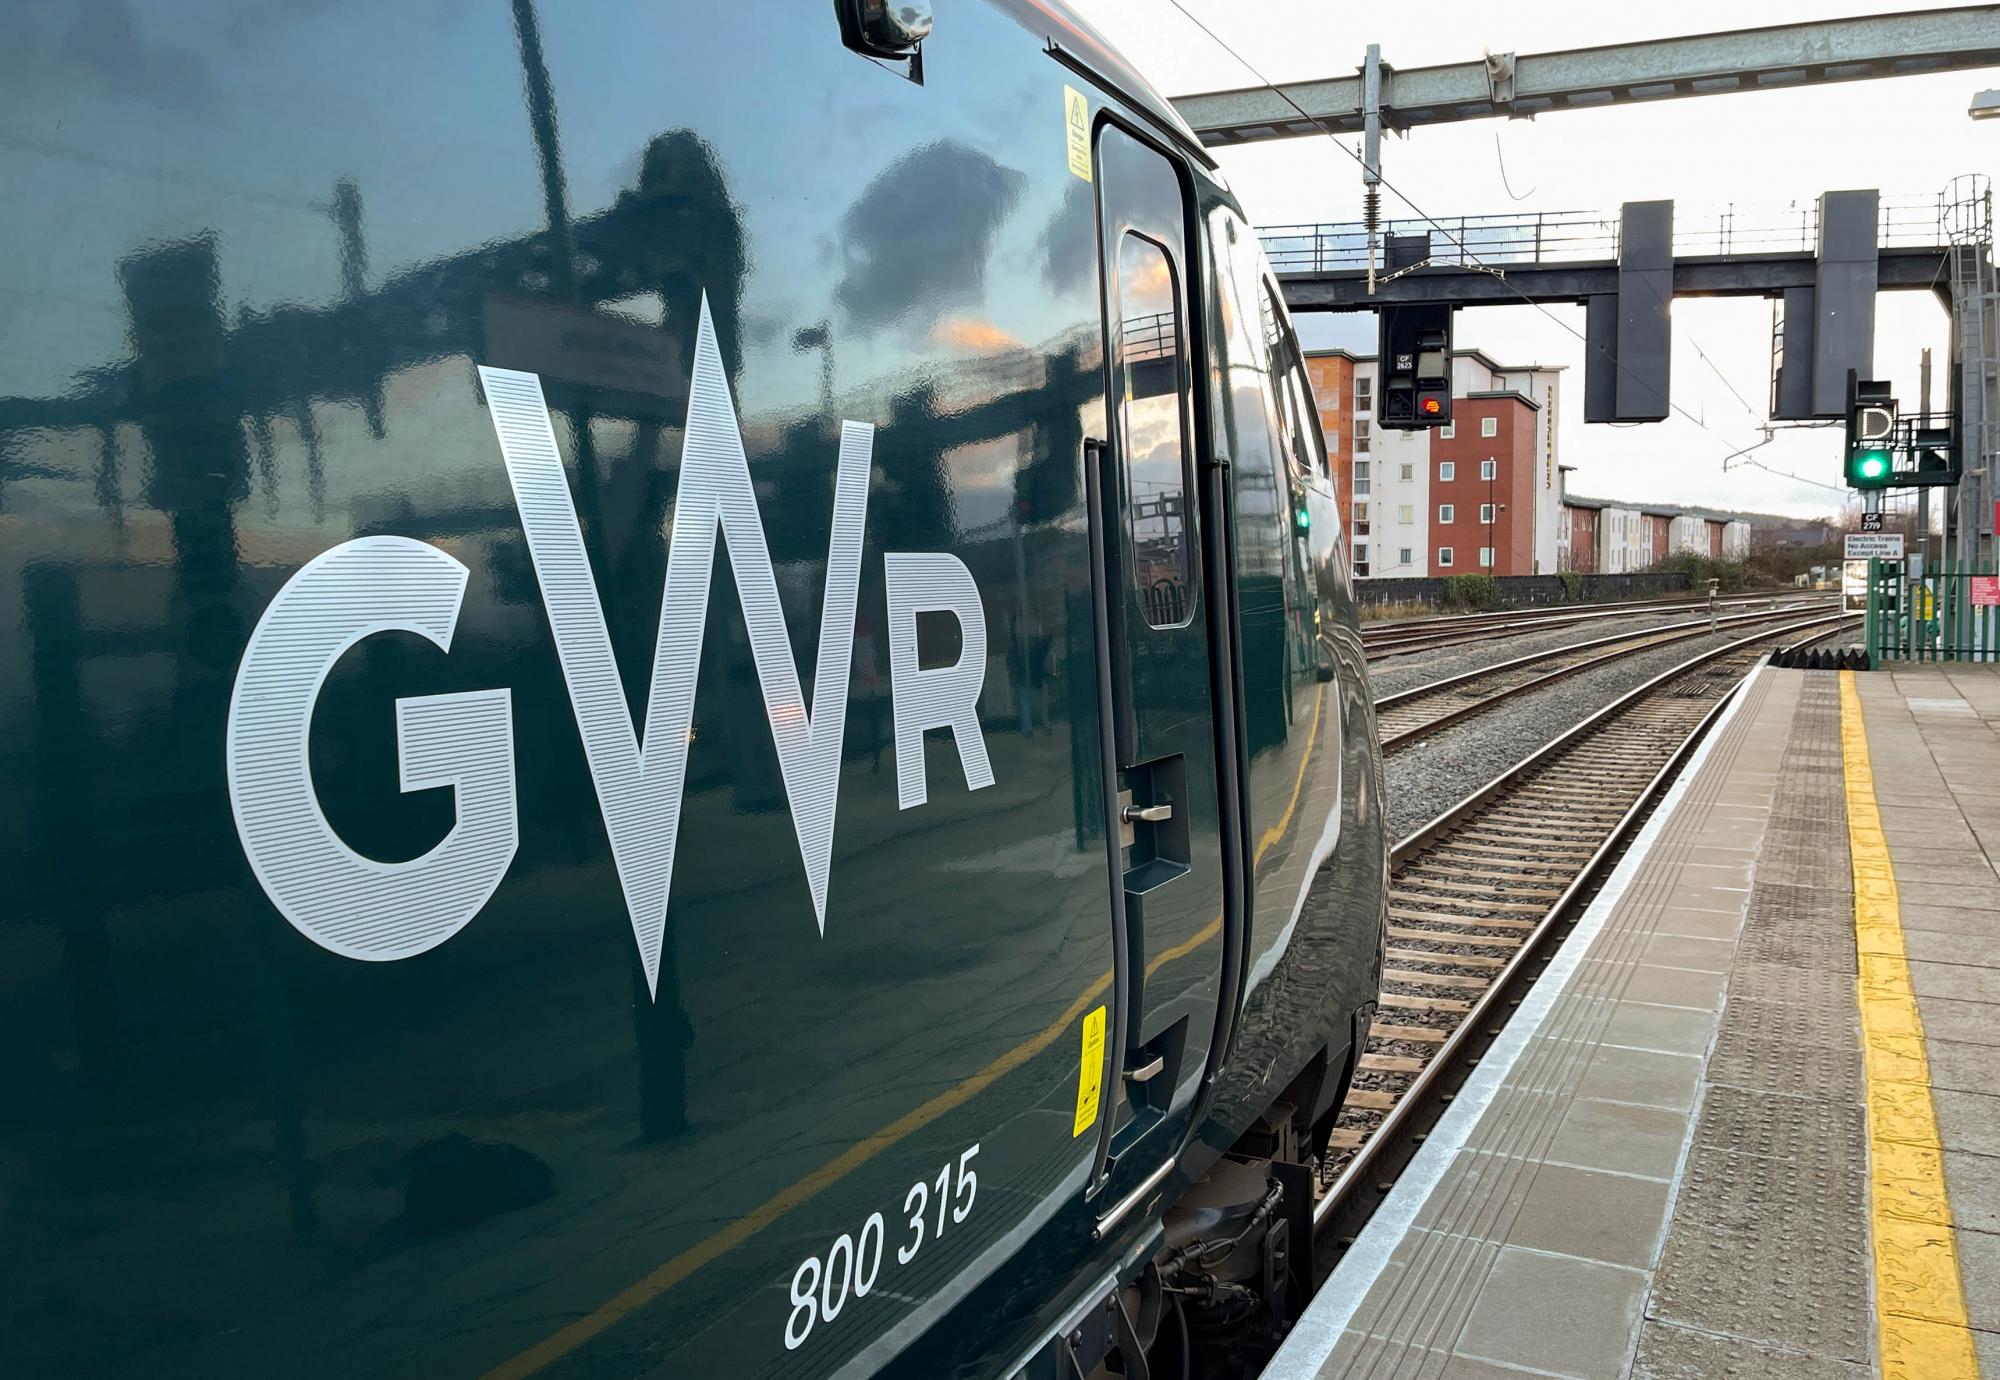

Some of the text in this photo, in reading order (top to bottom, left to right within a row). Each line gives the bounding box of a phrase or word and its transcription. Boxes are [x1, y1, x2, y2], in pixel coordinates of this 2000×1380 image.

[1862, 408, 1893, 440] D
[1863, 522, 1881, 530] 2719
[226, 286, 996, 1005] GWR
[784, 1142, 980, 1351] 800 315
